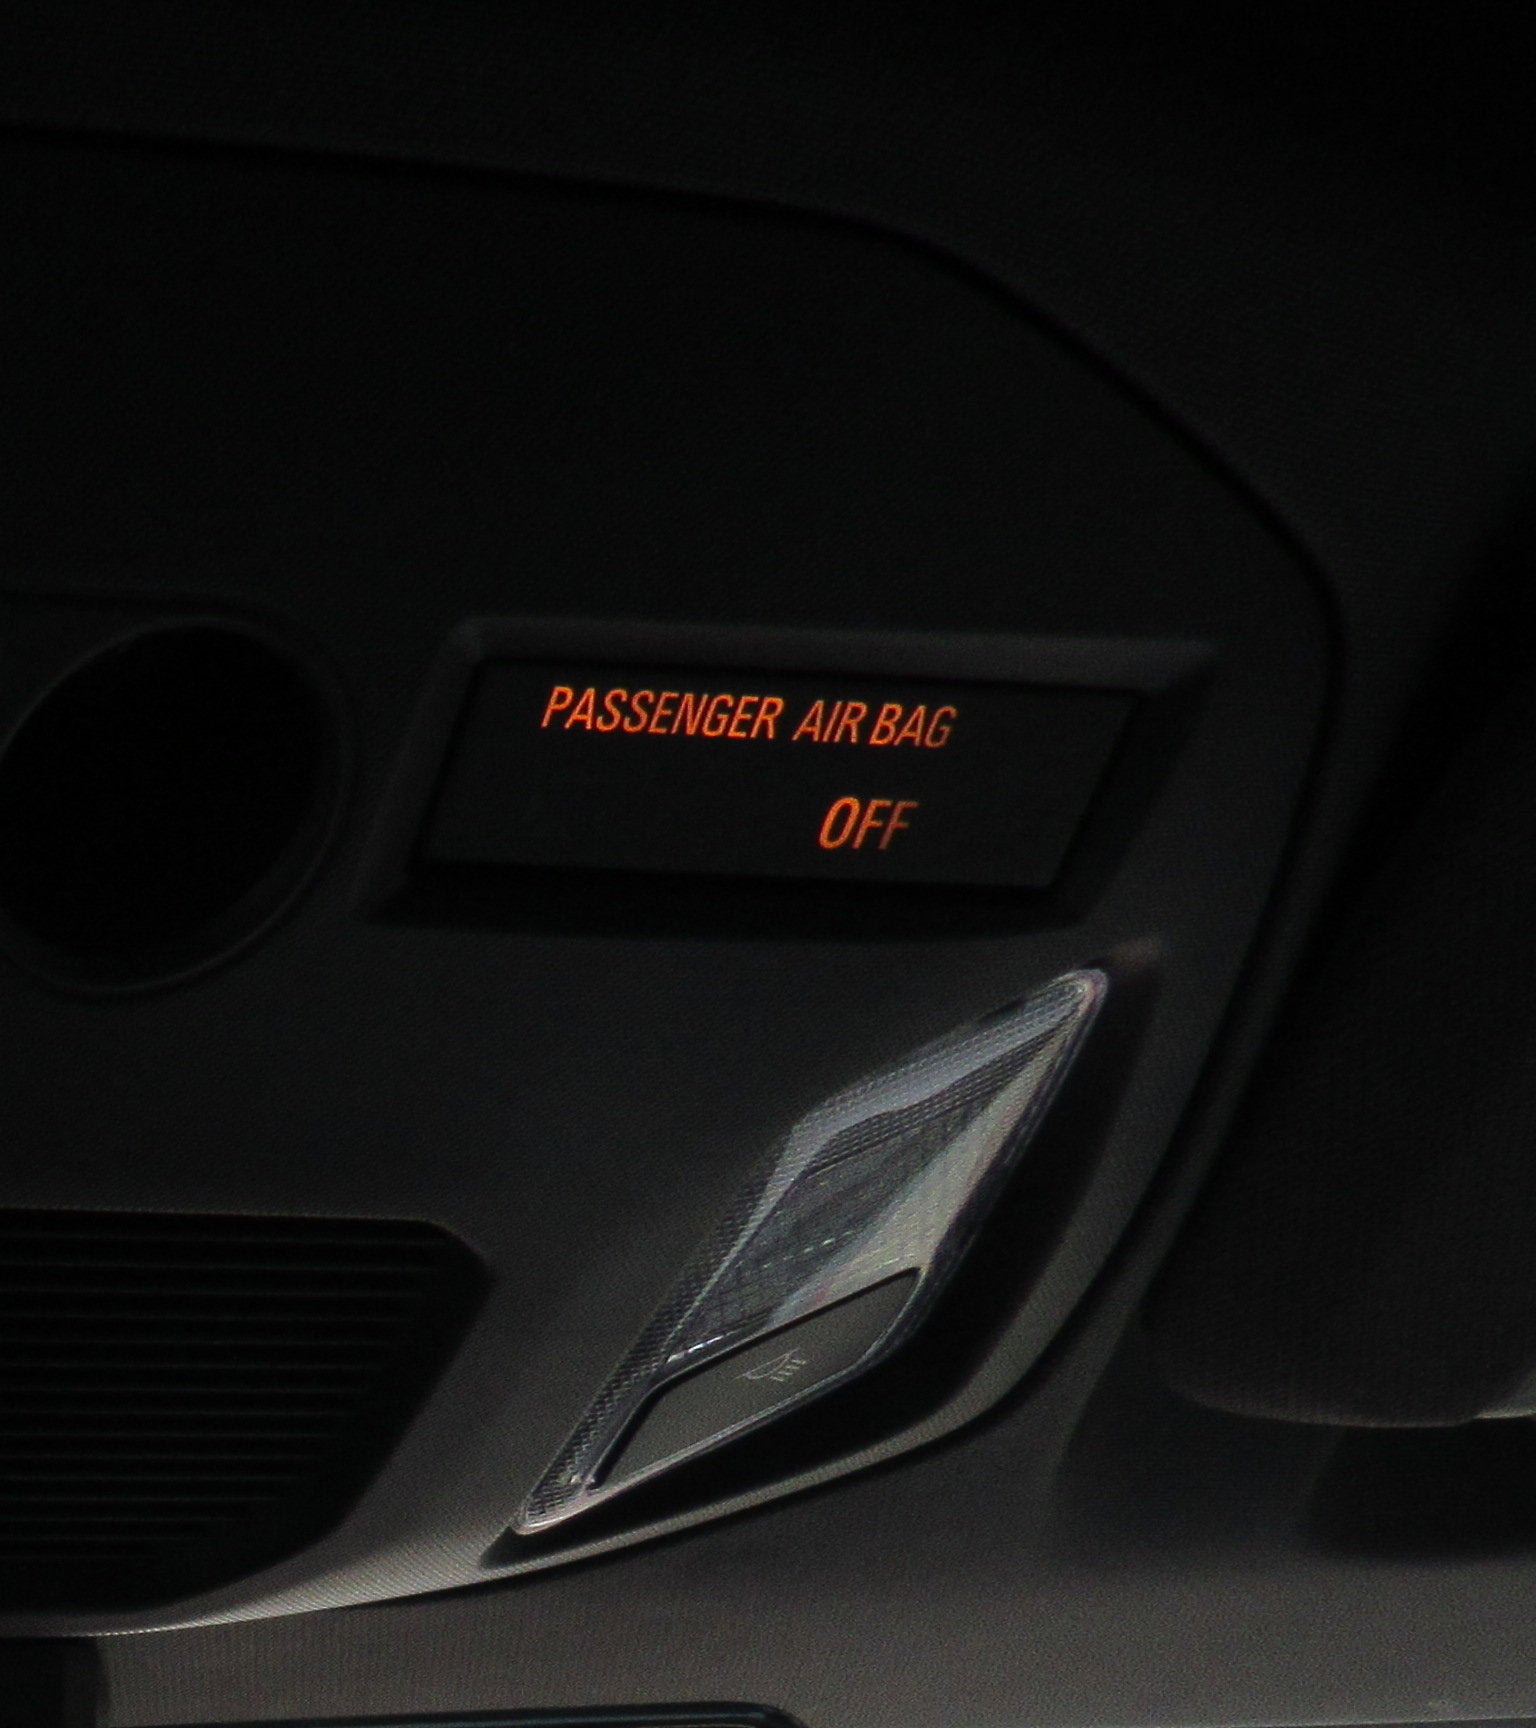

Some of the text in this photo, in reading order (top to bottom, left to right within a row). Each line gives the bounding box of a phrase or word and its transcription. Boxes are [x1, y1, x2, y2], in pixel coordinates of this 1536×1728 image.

[540, 686, 958, 749] PASSENGER AIR BAG
[817, 796, 920, 850] OFF
